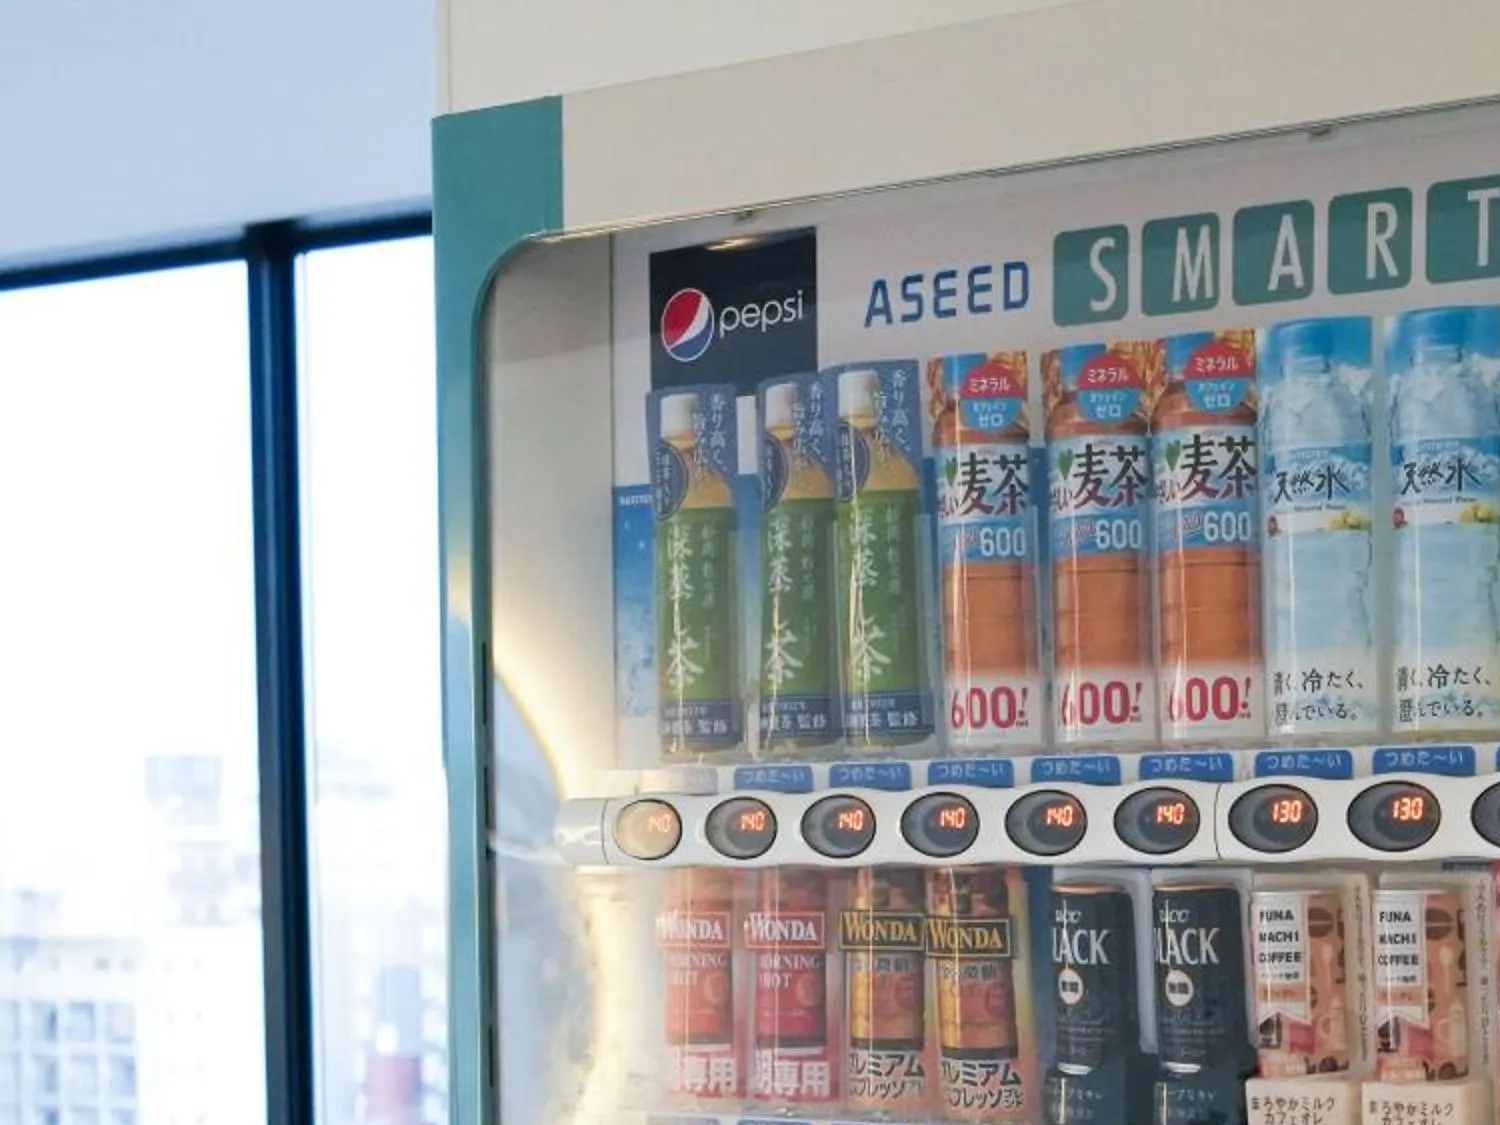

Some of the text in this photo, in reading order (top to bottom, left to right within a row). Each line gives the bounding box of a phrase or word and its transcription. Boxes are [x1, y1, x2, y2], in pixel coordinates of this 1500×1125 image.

[864, 260, 1030, 327] ASEED
[718, 288, 804, 339] pepsi
[1087, 368, 1130, 383] ミネラル
[1195, 356, 1238, 371] ミネラル
[969, 378, 1011, 393] ミネラル
[1096, 404, 1122, 418] ゼロ
[1204, 394, 1231, 408] ゼロ
[979, 414, 1004, 428] ゼロ
[1073, 444, 1146, 509] 麦茶
[1181, 434, 1257, 499] 麦茶
[1401, 458, 1482, 495] 天然水
[958, 453, 1028, 516] 麦茶
[1275, 465, 1350, 503] 天然水
[1095, 519, 1143, 549] 600
[1203, 511, 1251, 542] 600
[979, 528, 1026, 557] 600
[741, 811, 765, 832] 140
[838, 810, 863, 830] 140
[940, 808, 966, 828] 140
[1046, 806, 1073, 827] 140
[1156, 804, 1185, 825] 140
[1272, 800, 1302, 823] 130
[1392, 797, 1423, 820] 130
[750, 911, 817, 941] WONDA
[843, 911, 918, 944] WONDA
[927, 919, 1002, 948] WONDA
[1052, 927, 1110, 965] LACK
